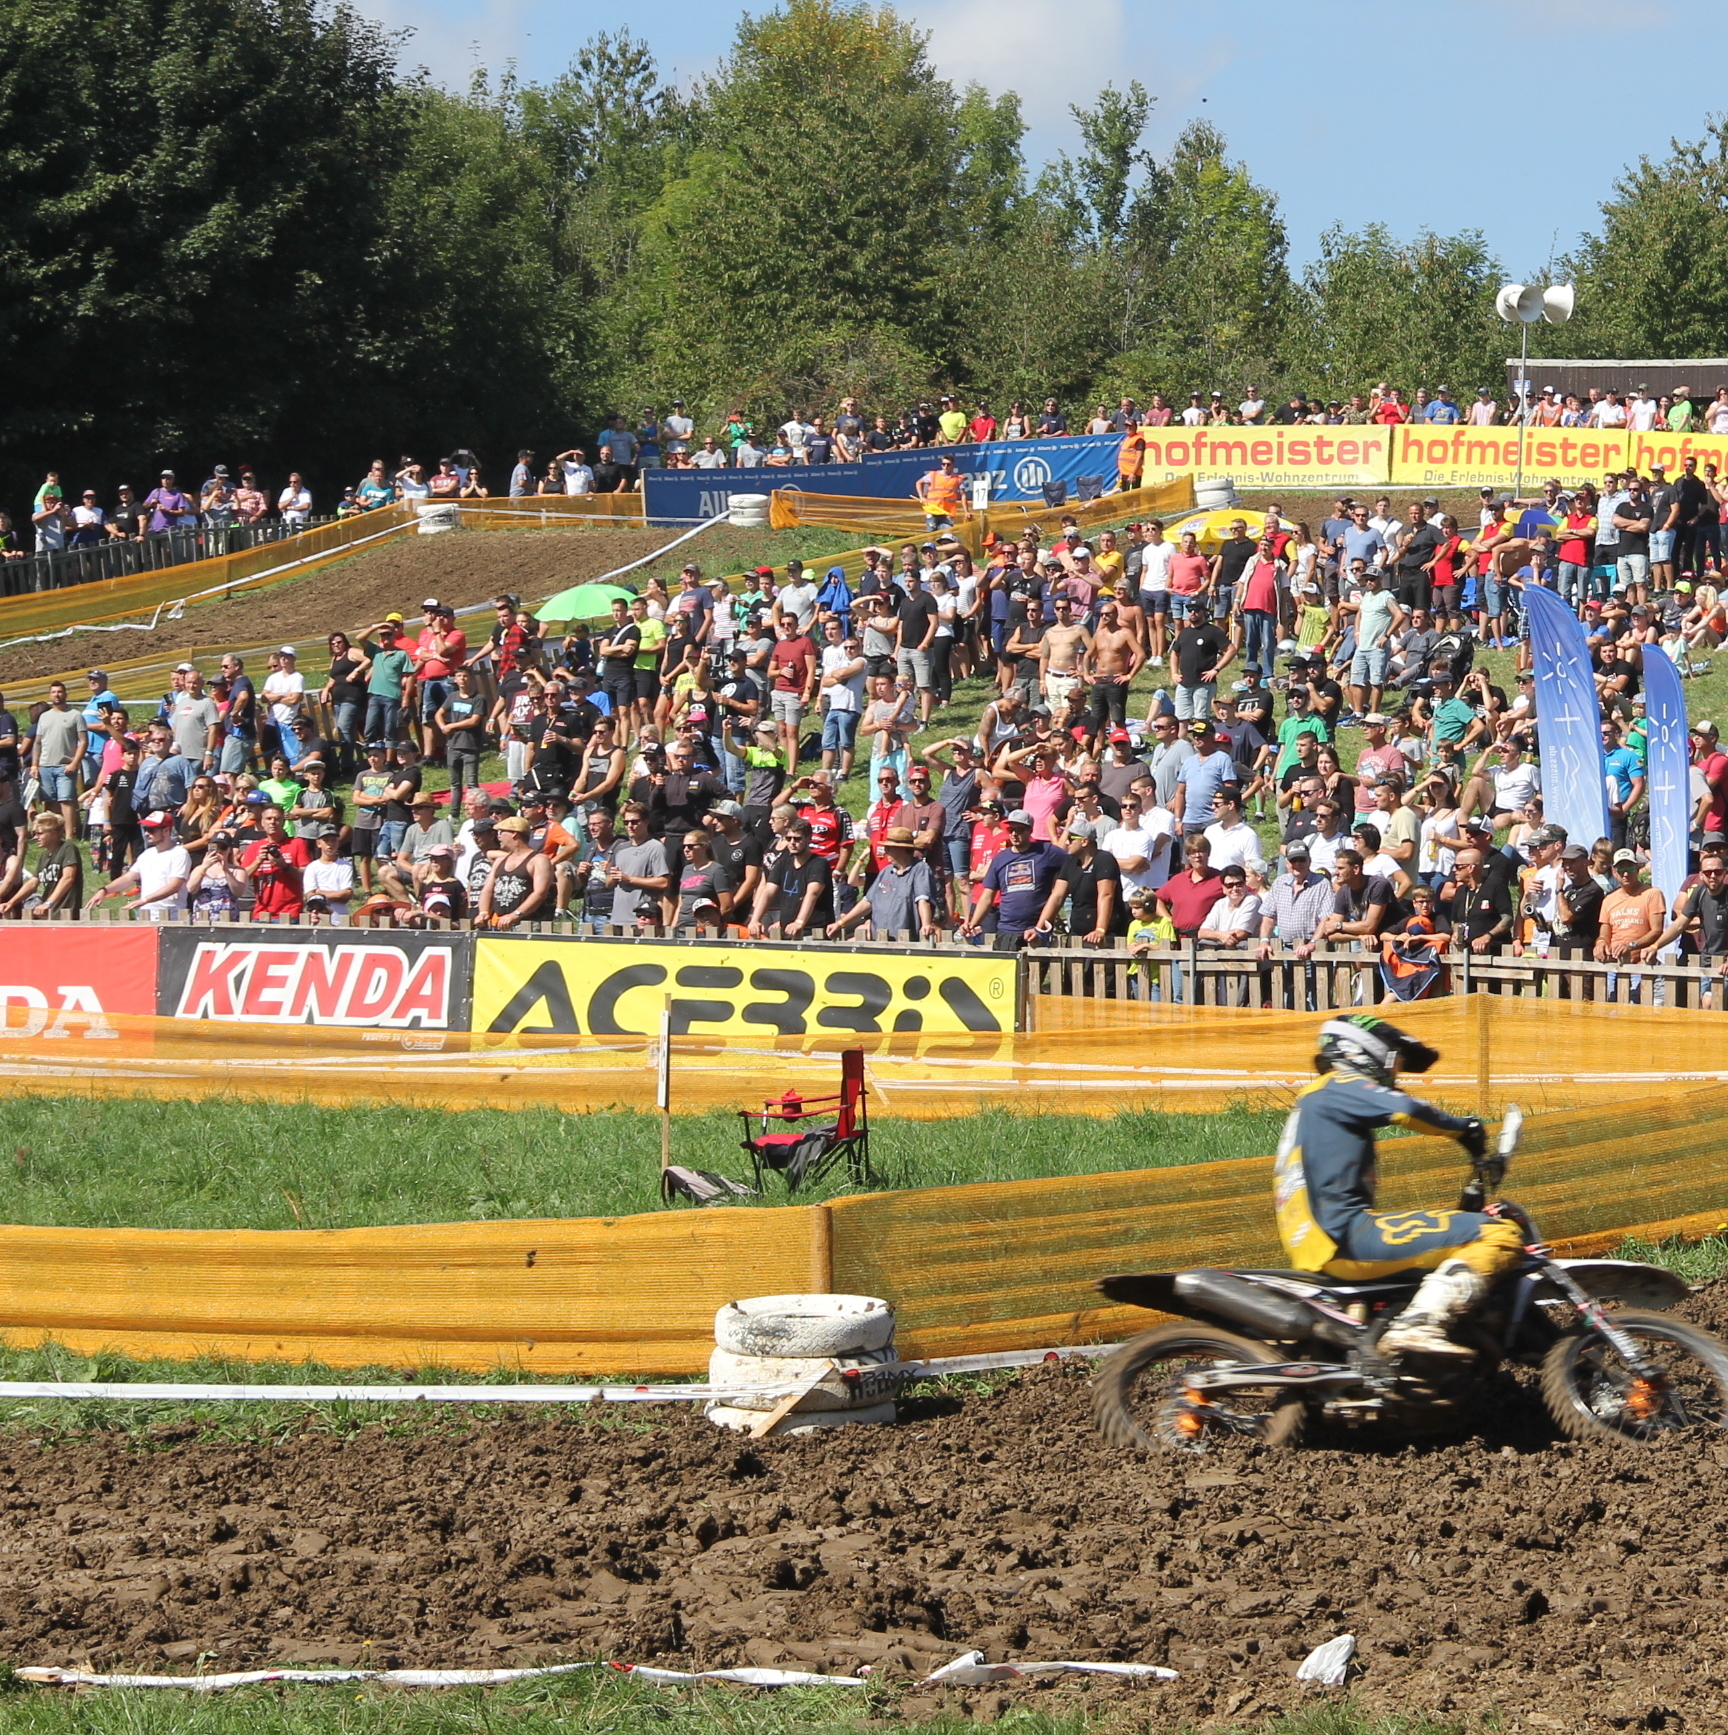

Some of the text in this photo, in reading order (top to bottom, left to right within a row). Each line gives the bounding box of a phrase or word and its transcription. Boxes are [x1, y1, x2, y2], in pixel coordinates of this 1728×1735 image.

[1141, 431, 1382, 466] hofmeister
[1402, 429, 1621, 468] hofmeister
[1165, 472, 1359, 482] De Erlebnis-Wohnzentrum
[1424, 470, 1445, 481] Die
[974, 488, 987, 502] 17
[177, 942, 453, 1028] KENDA
